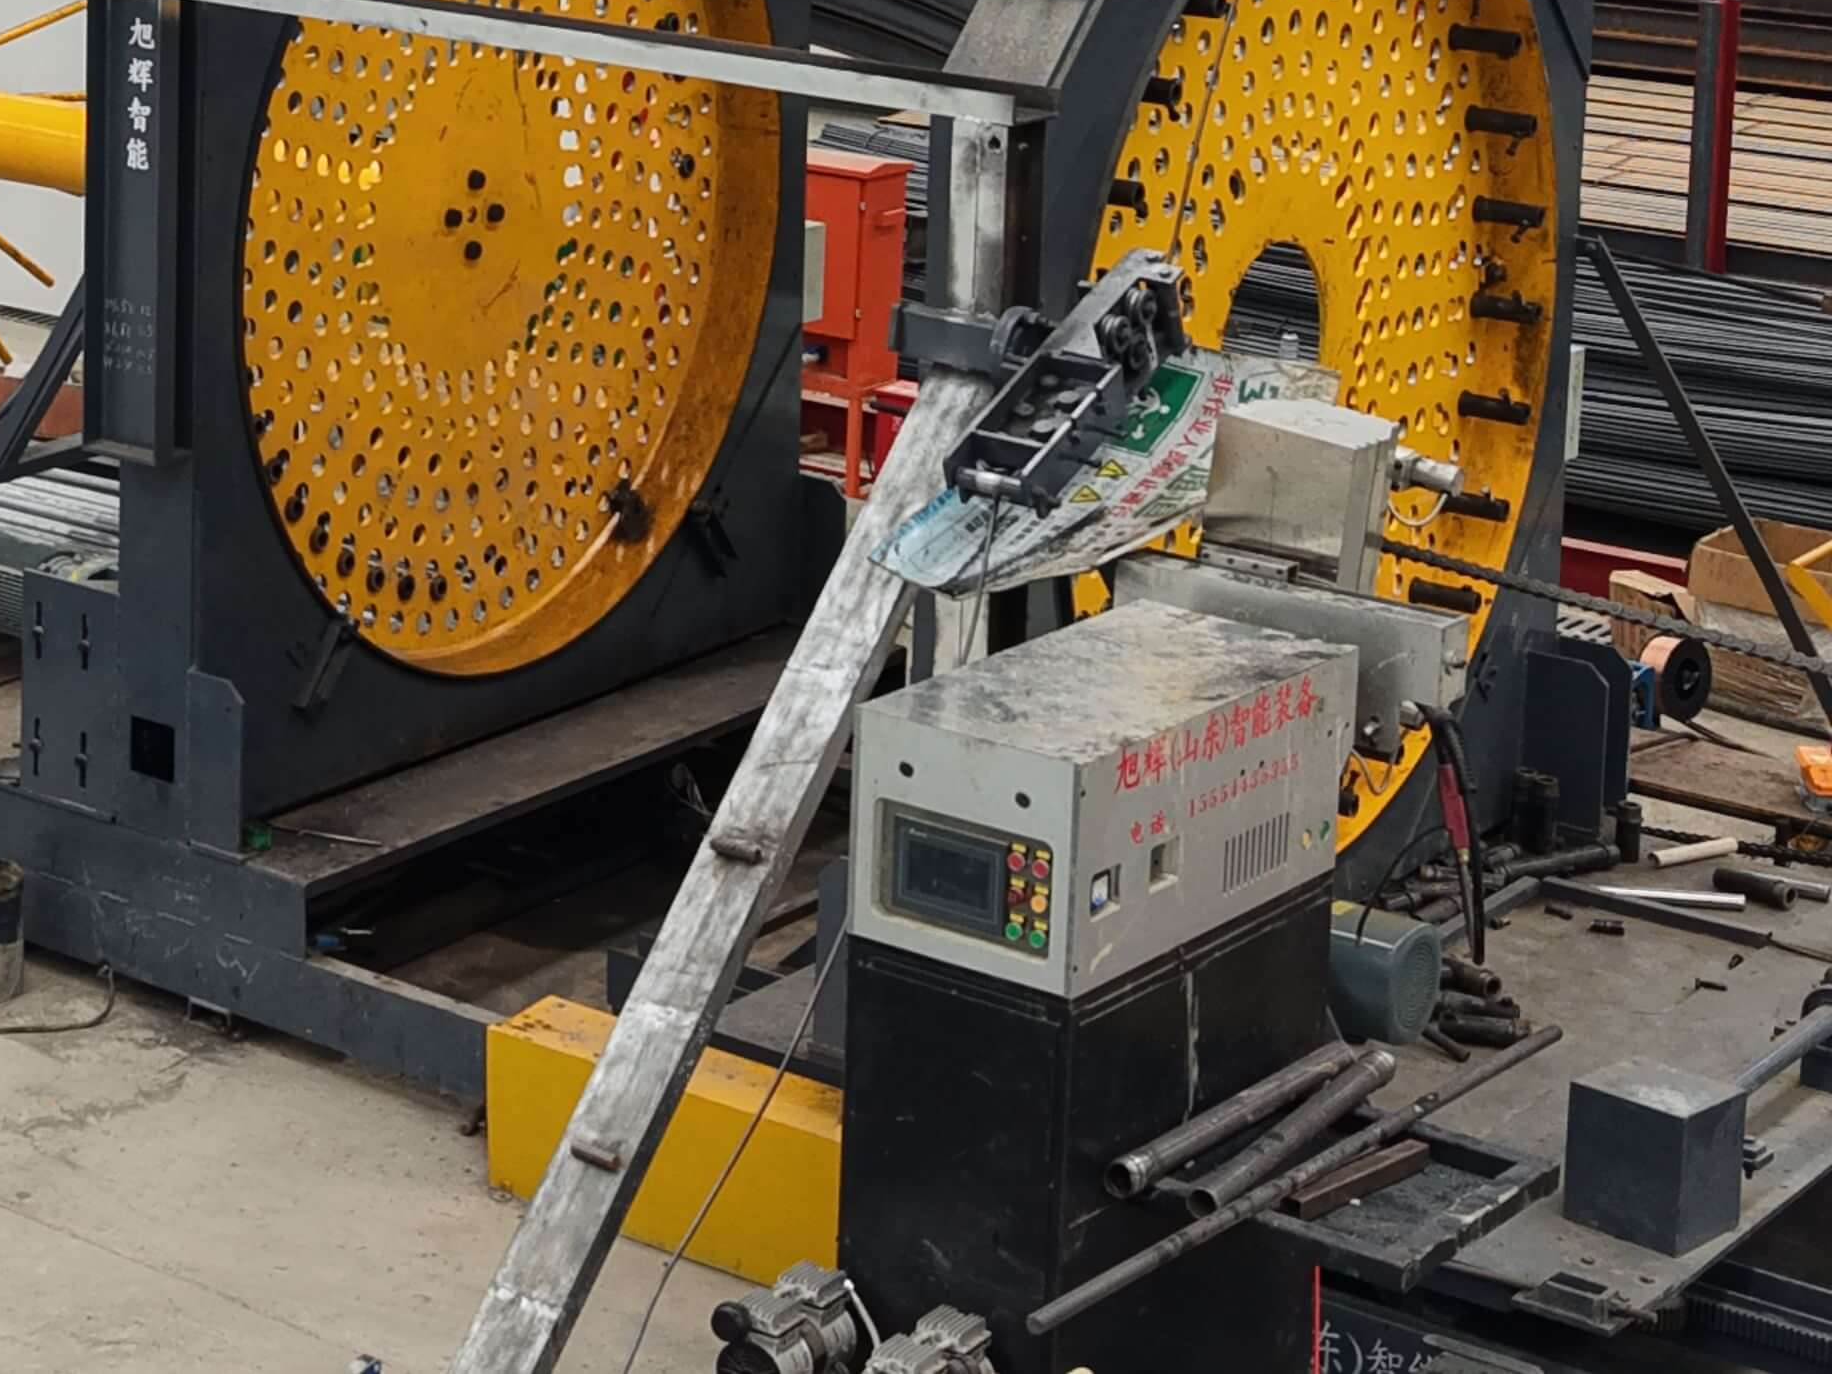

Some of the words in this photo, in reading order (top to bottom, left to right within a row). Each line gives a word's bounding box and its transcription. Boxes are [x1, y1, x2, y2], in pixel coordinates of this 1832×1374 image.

[126, 18, 156, 171] 旭辉智能
[1114, 674, 1319, 794] 旭辉(山东)智能装备
